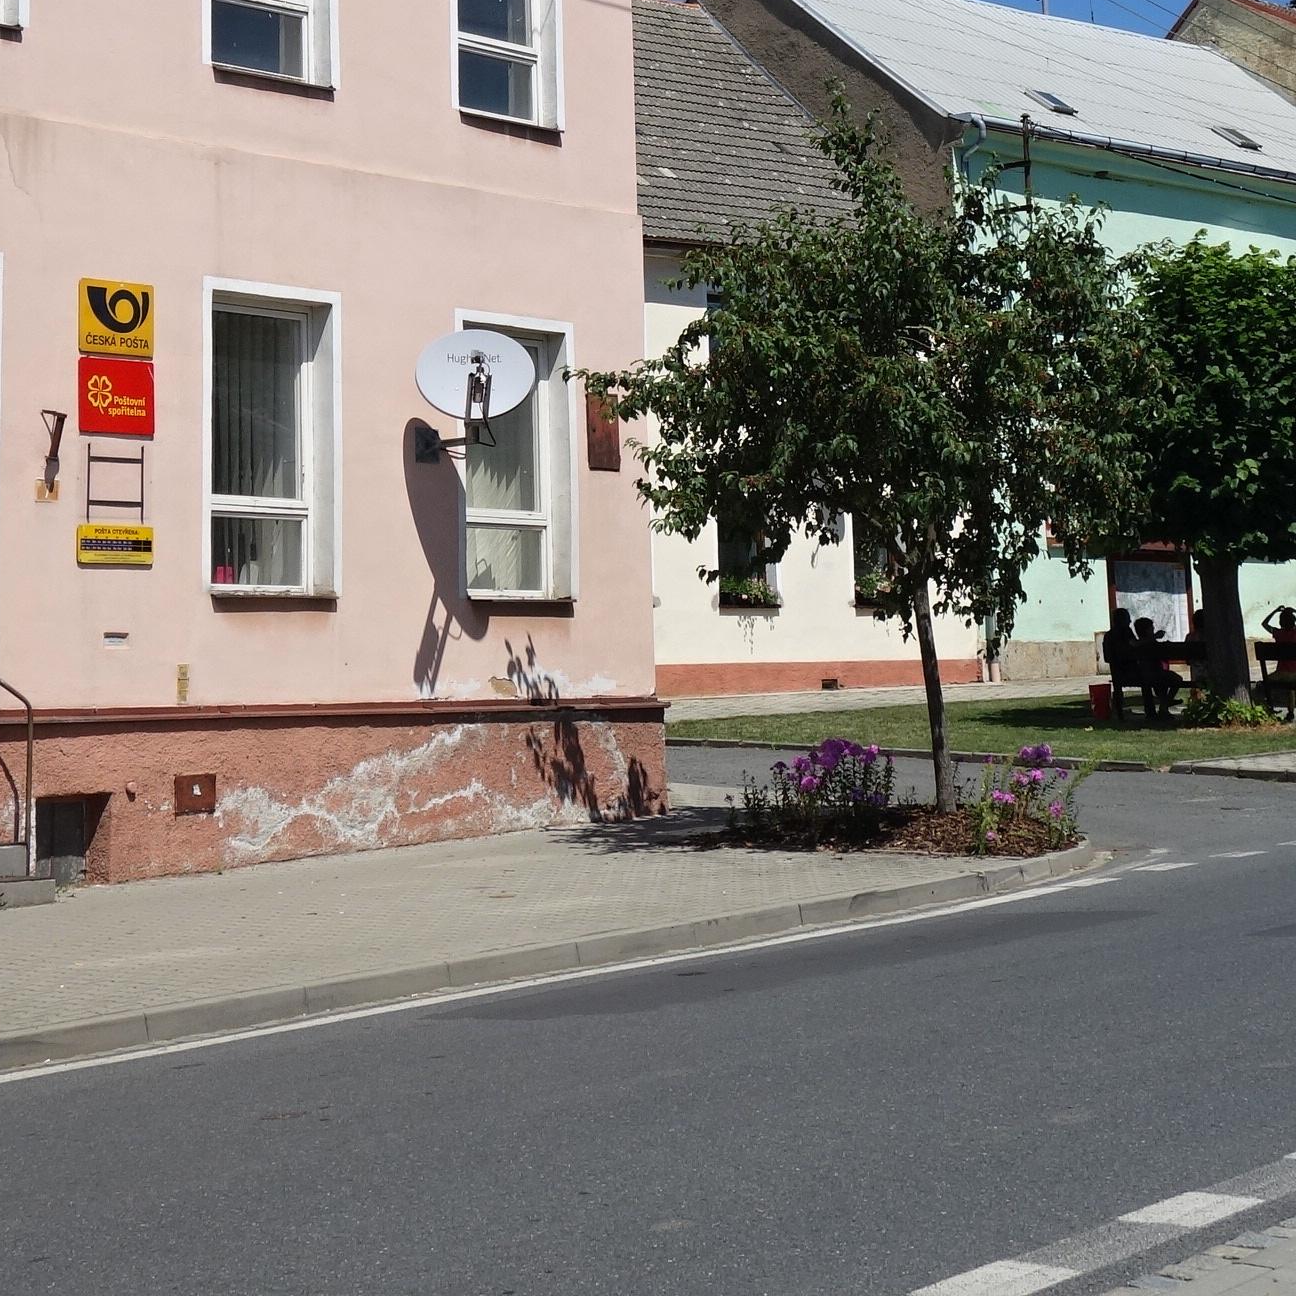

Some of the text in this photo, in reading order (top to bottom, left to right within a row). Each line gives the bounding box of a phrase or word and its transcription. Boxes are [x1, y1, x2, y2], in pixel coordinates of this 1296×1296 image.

[85, 332, 149, 349] ČESKÁ POŠTA
[113, 395, 146, 407] Poštovní
[108, 406, 146, 417] spořitelna
[95, 527, 111, 535] POŠTA
